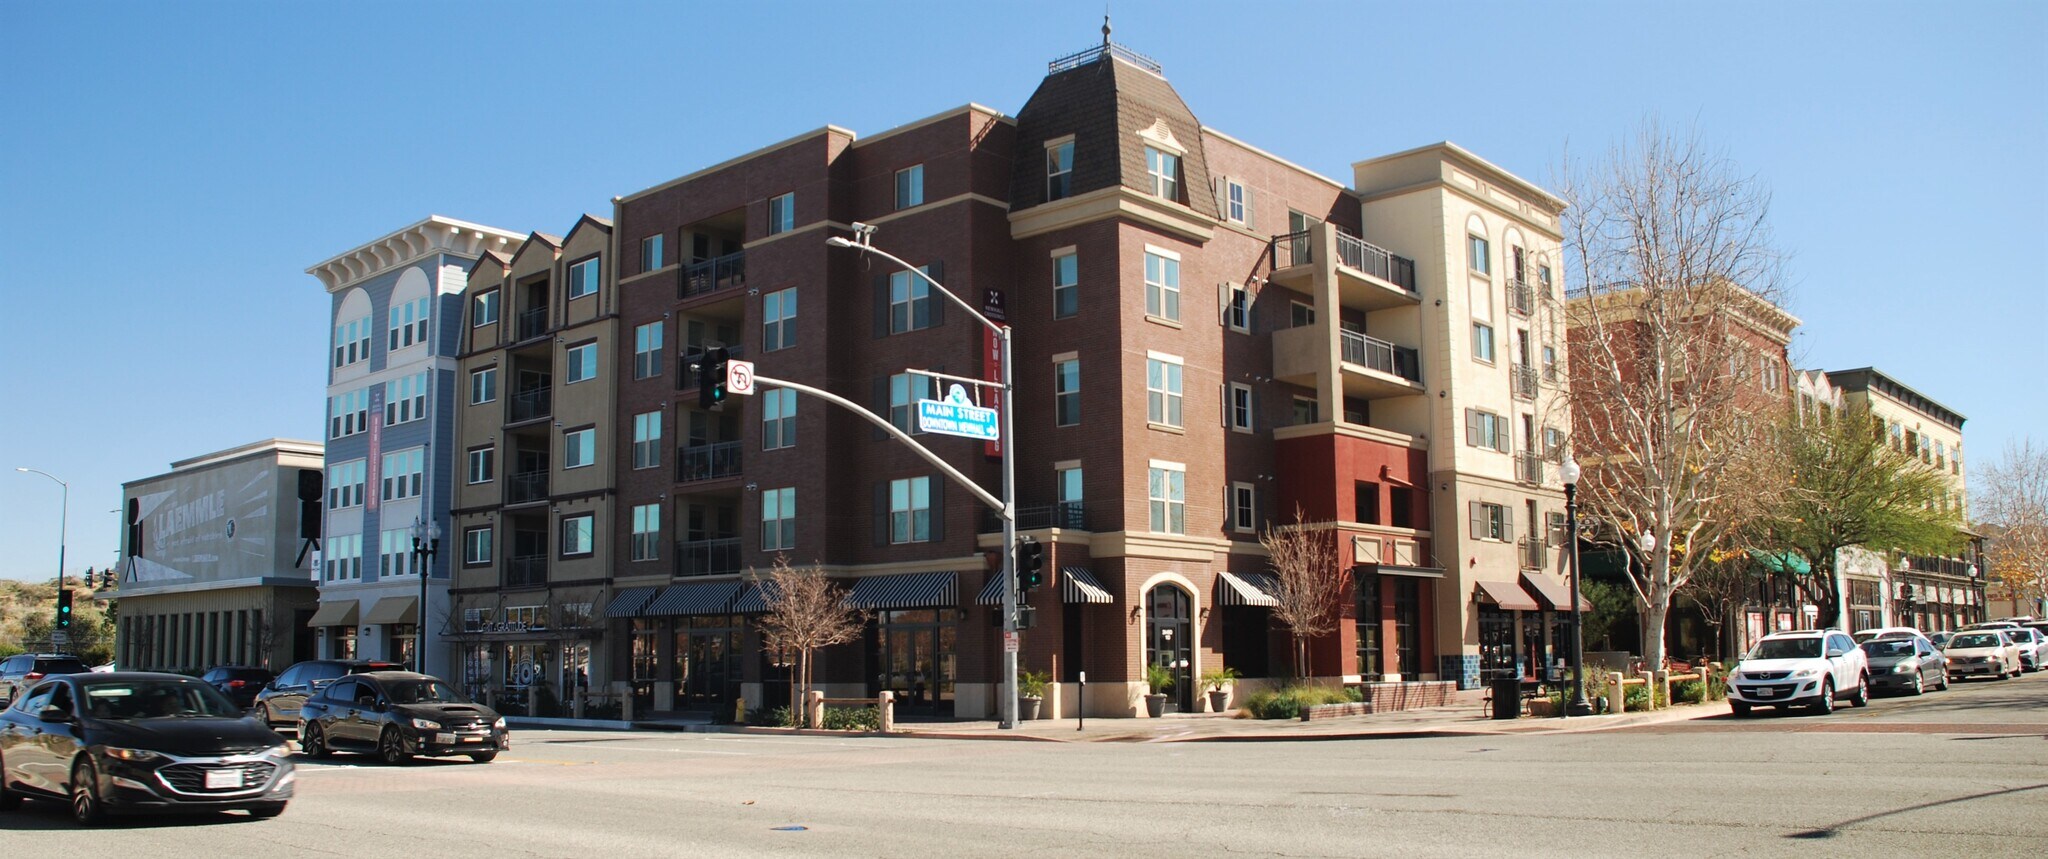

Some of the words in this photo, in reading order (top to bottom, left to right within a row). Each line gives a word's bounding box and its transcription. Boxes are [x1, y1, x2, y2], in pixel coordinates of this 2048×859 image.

[925, 403, 955, 418] MAIN
[957, 406, 991, 423] STREET
[158, 488, 225, 540] LAEMMLE
